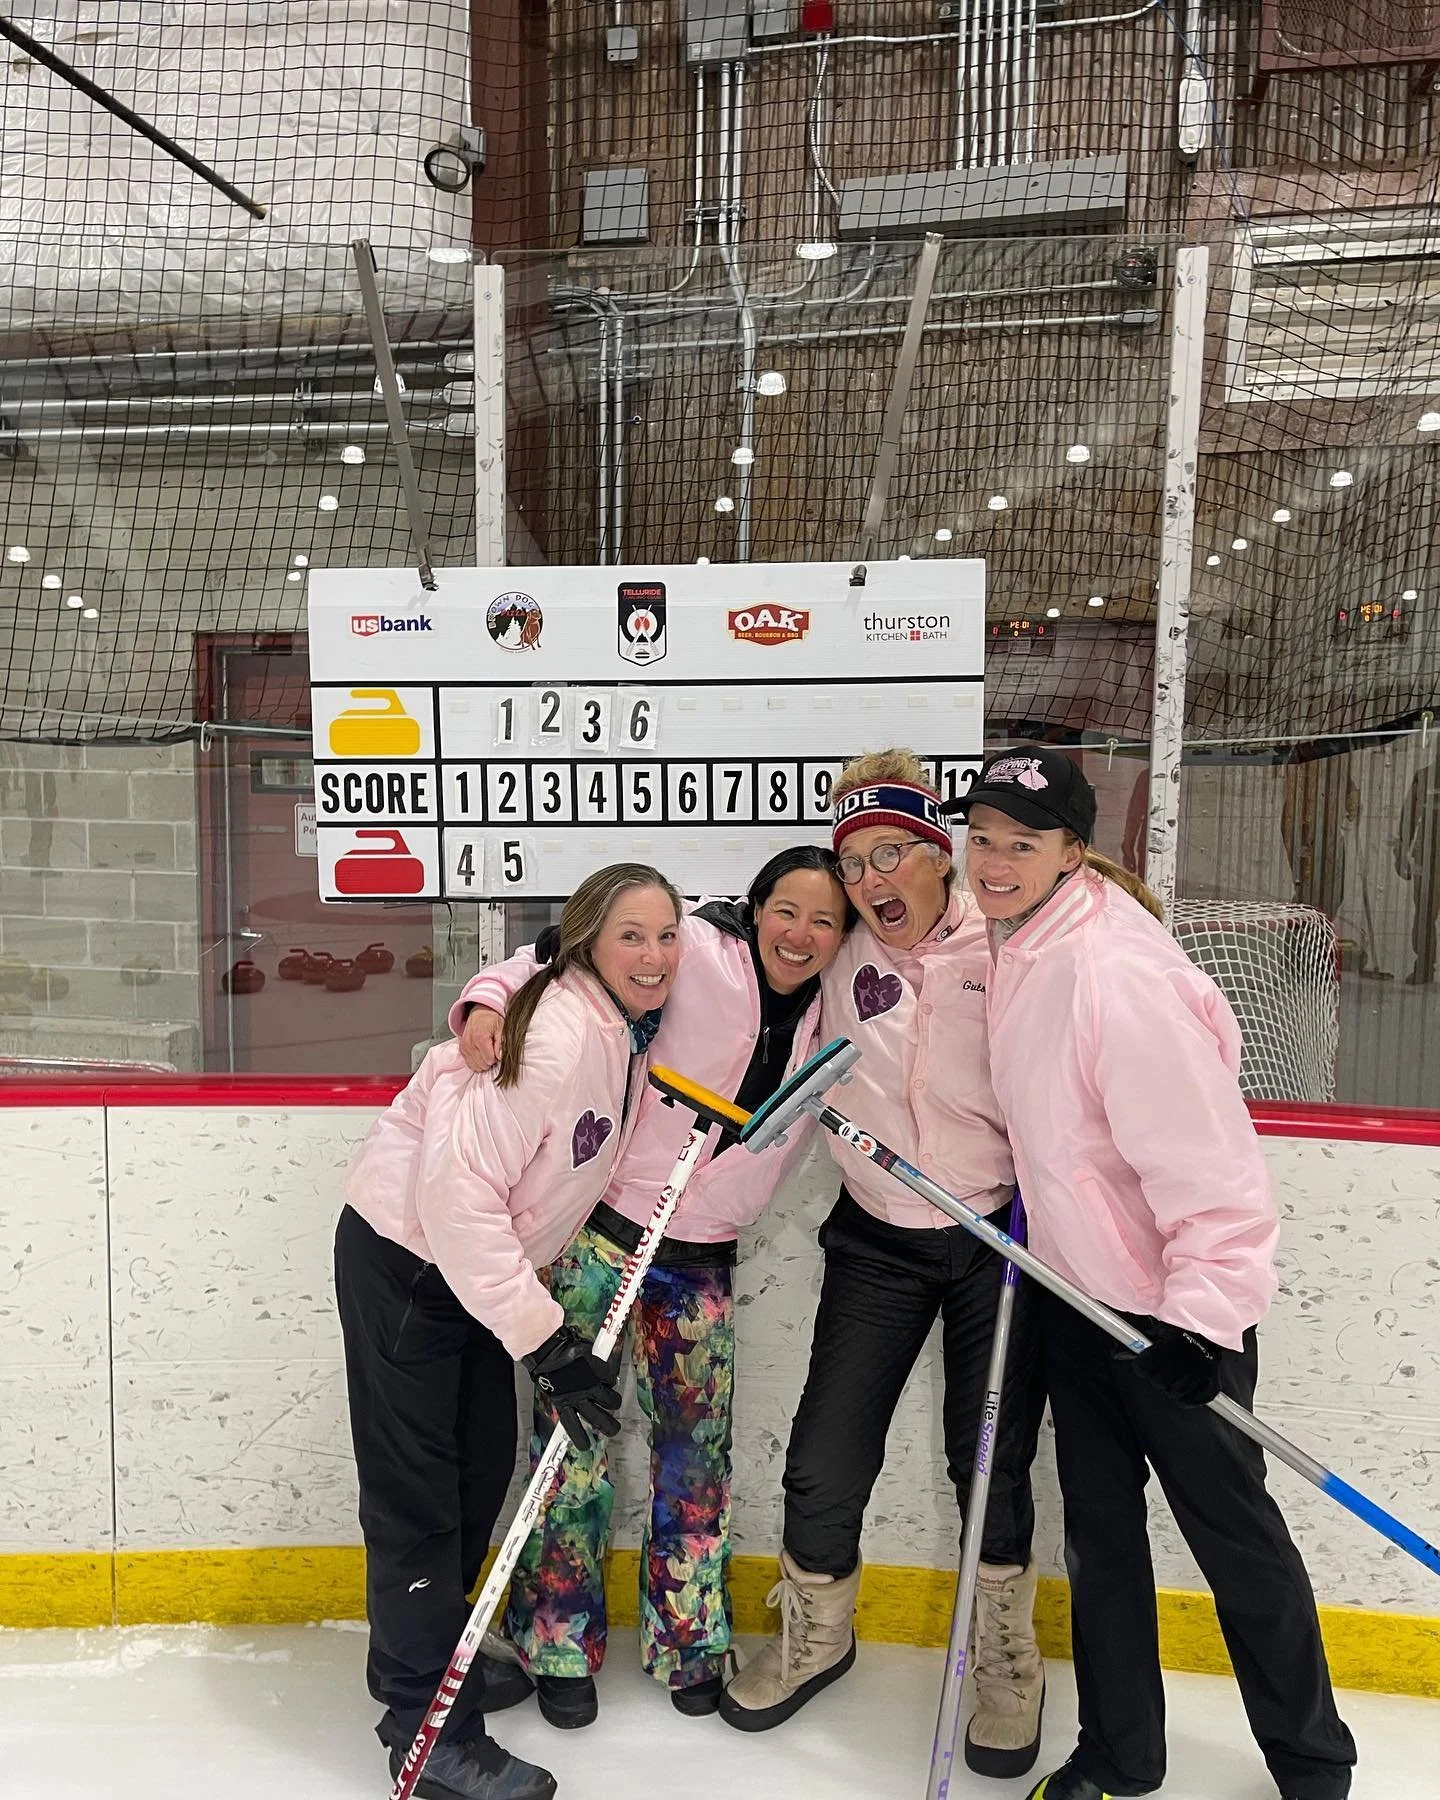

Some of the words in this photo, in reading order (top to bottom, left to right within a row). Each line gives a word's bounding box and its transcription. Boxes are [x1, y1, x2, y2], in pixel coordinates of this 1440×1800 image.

[622, 588, 662, 596] TELLURIDE
[487, 595, 510, 629] BROWN
[734, 609, 803, 631] OAK
[863, 612, 950, 630] thurston
[866, 633, 908, 641] KITCHEN
[922, 631, 947, 640] BATH
[500, 698, 512, 741] 1
[541, 691, 560, 733] 2
[582, 700, 601, 743] 3
[629, 700, 649, 742] 6
[321, 772, 429, 815] SCORE
[456, 771, 468, 814] 1
[498, 771, 517, 814] 2
[542, 771, 562, 814] 3
[588, 771, 607, 814] 4
[632, 771, 652, 814] 5
[678, 771, 697, 814] 6
[723, 770, 743, 813] 7
[769, 770, 788, 813] 8
[814, 770, 832, 813] 9
[457, 844, 475, 887] 4
[503, 840, 523, 882] 5
